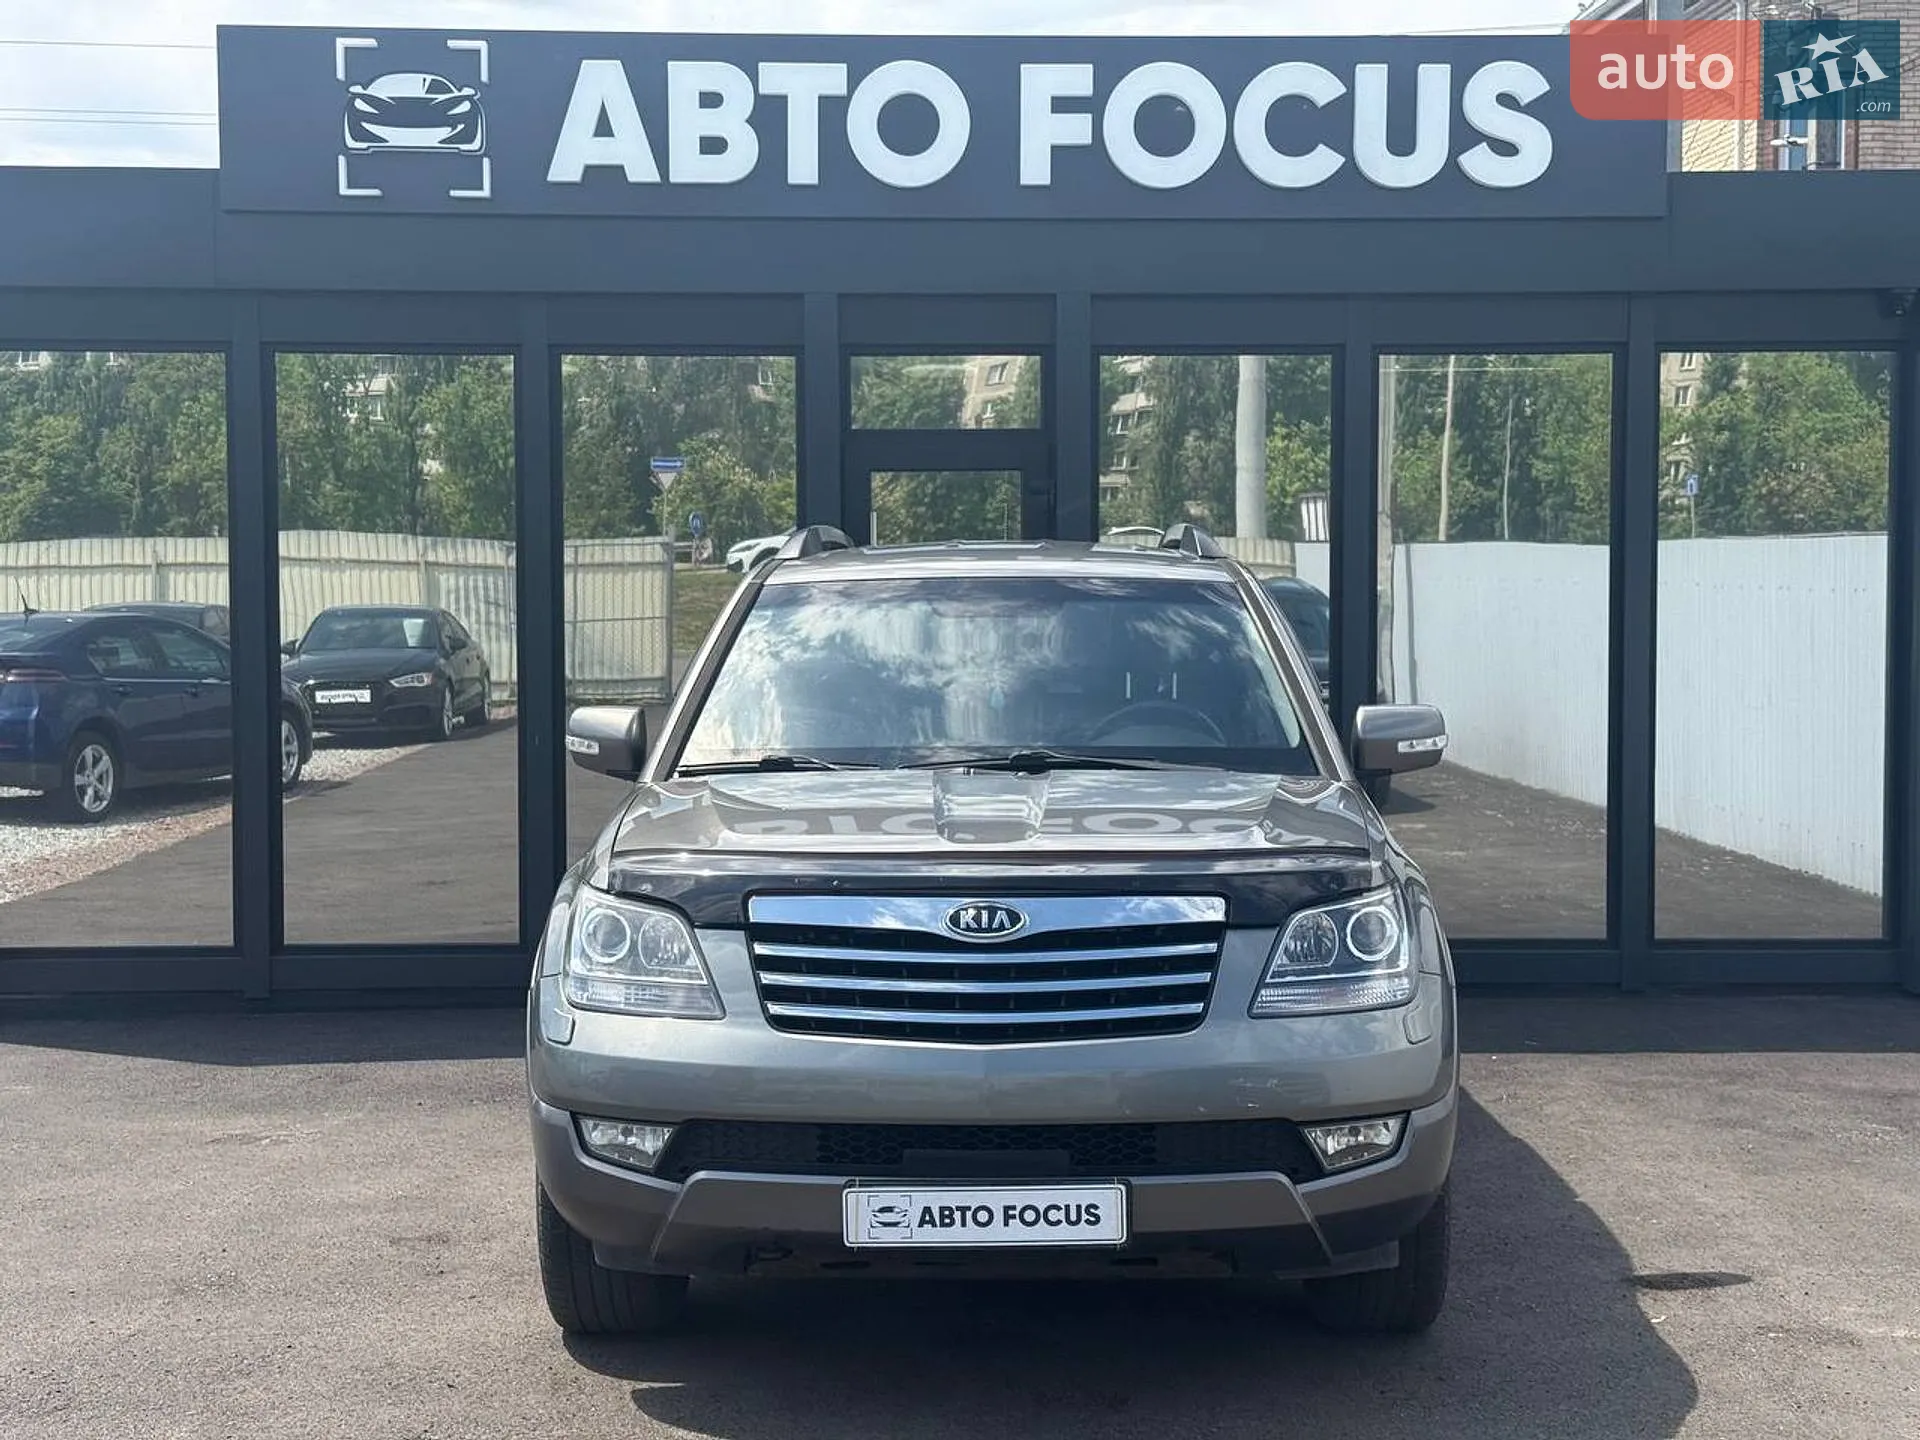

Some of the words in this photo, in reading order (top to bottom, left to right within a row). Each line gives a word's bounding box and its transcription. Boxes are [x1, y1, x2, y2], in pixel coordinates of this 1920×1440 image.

[546, 59, 971, 187] АВТО
[1019, 60, 1553, 190] FOCUS
[959, 909, 1012, 929] KIA
[917, 1204, 994, 1228] АВТО
[1002, 1203, 1101, 1227] FOCUS
